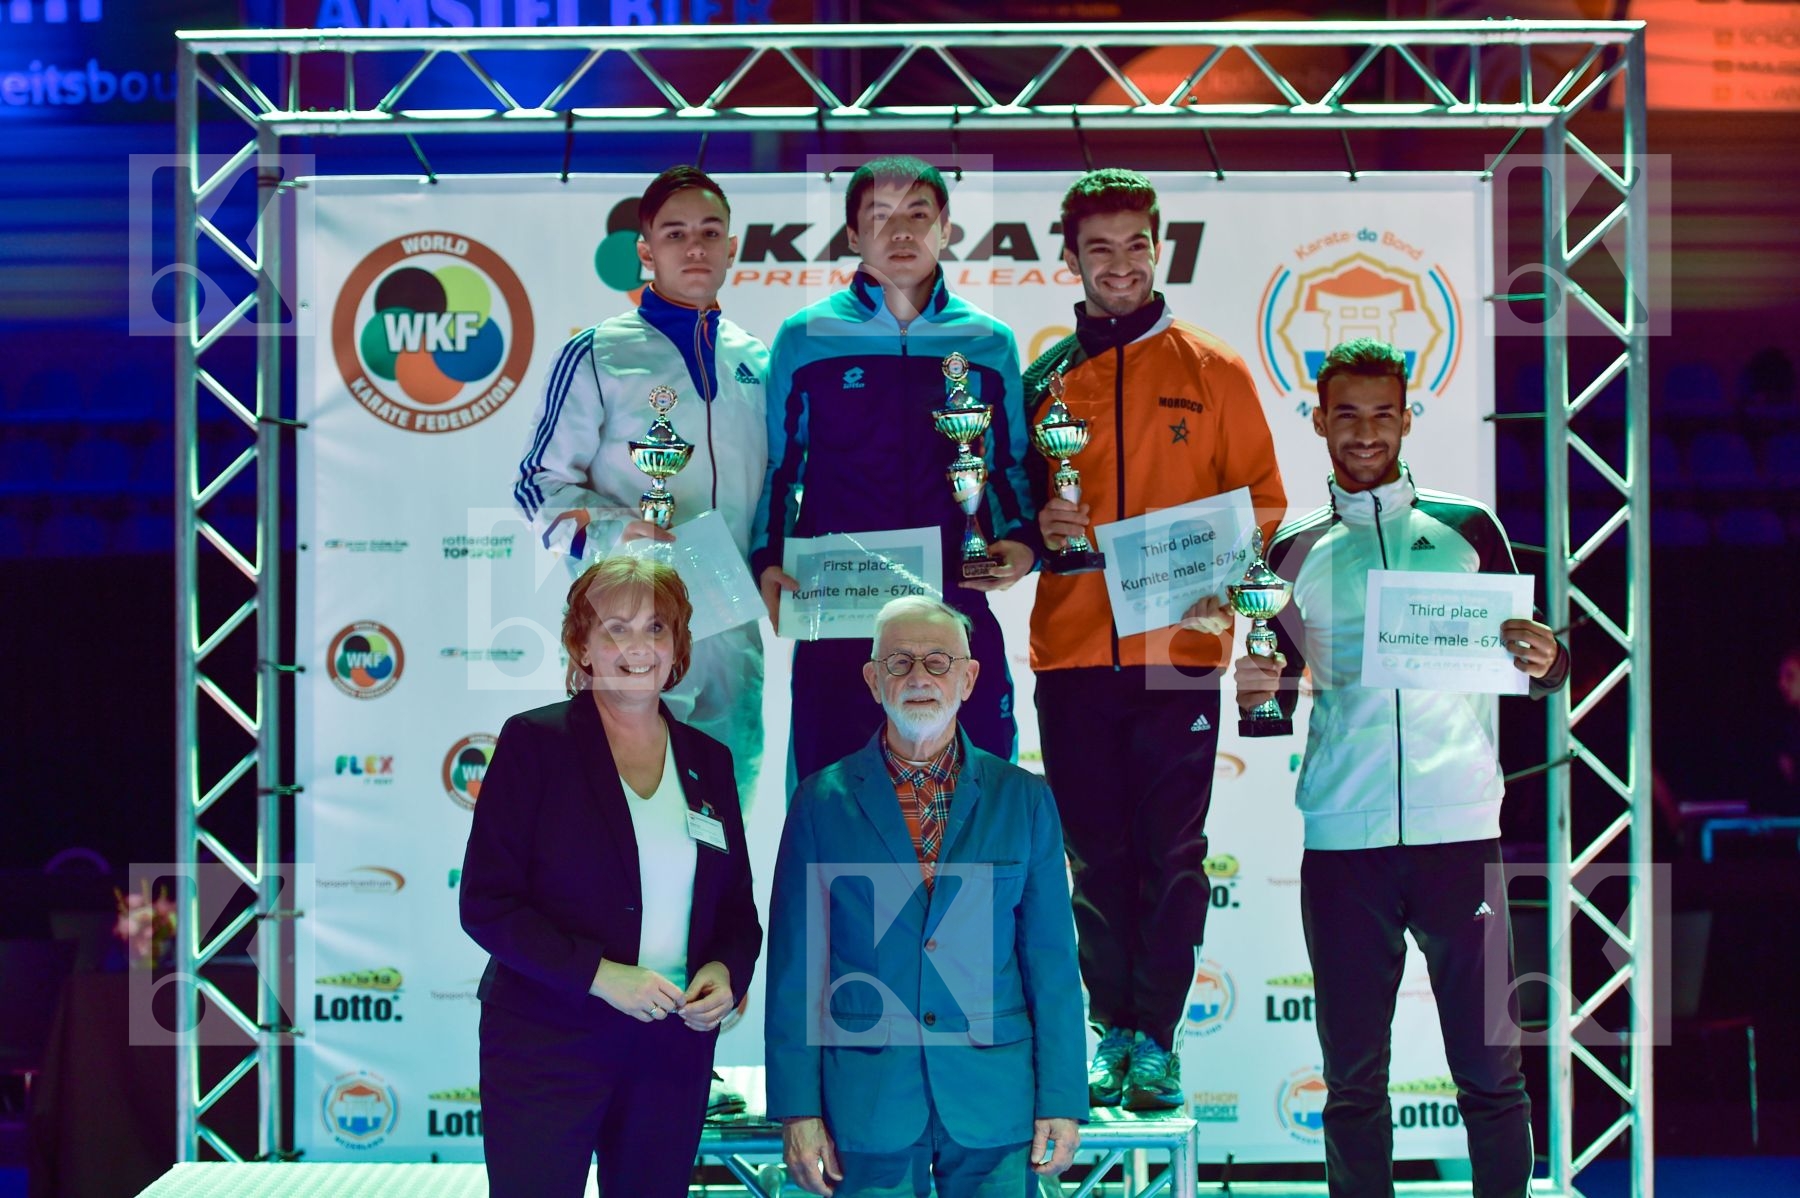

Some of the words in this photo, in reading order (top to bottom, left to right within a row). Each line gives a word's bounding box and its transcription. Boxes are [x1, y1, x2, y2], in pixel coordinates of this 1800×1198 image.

[402, 235, 469, 256] WORLD
[732, 269, 854, 287] PREM
[959, 268, 1081, 286] LEAG
[384, 312, 480, 352] WKF
[351, 376, 409, 427] KARATE
[414, 376, 516, 431] FEDERATION
[1159, 397, 1203, 413] MOROCCO
[1141, 538, 1177, 558] Third
[1181, 529, 1217, 550] place
[823, 560, 853, 572] First
[858, 560, 896, 575] place
[1121, 570, 1170, 592] Kumite
[1173, 561, 1207, 579] male
[1210, 548, 1247, 567] -67kg
[792, 585, 840, 600] Kumite
[845, 585, 879, 597] male
[1409, 604, 1446, 617] Third
[1450, 605, 1489, 620] place
[1378, 631, 1429, 645] Kumite
[1434, 634, 1469, 647] male
[1474, 635, 1506, 648] -67k
[346, 652, 384, 668] WKF
[335, 755, 393, 776] FLEX
[462, 764, 487, 781] WK
[315, 994, 403, 1022] Lotto.
[428, 1109, 484, 1137] Lott
[1393, 1102, 1459, 1128] otto
